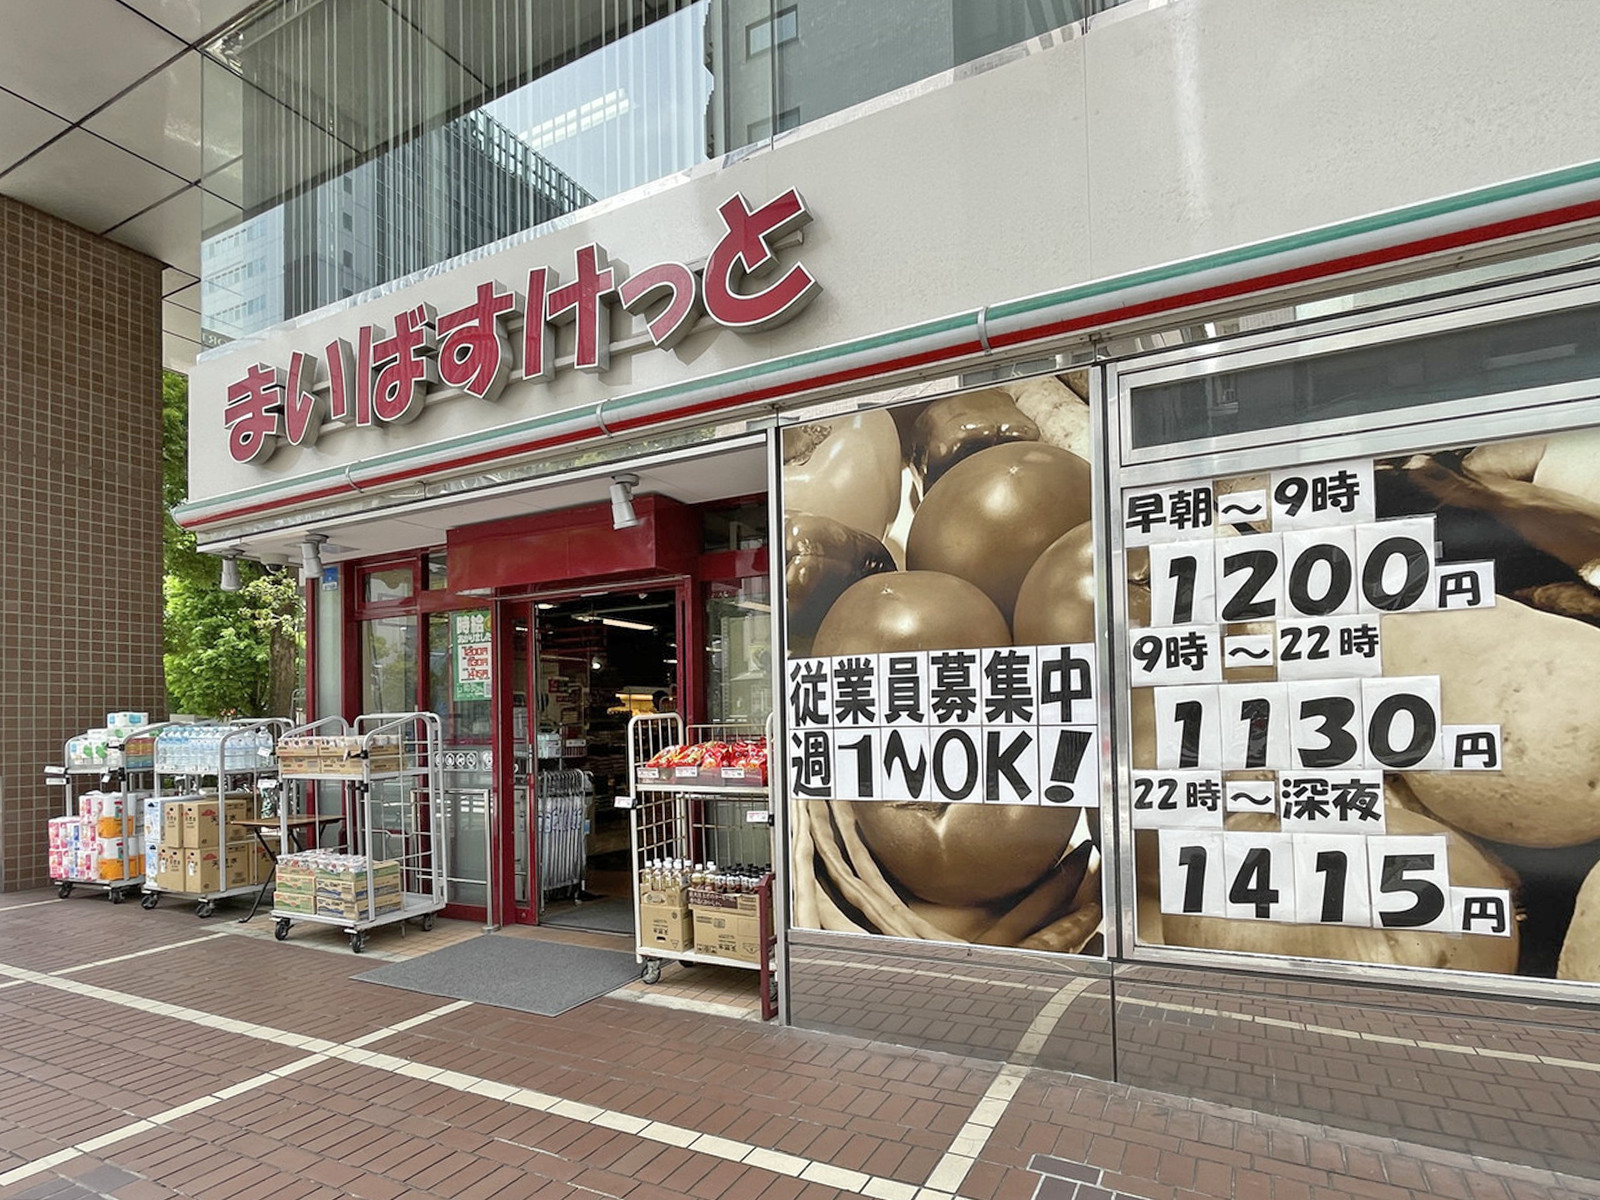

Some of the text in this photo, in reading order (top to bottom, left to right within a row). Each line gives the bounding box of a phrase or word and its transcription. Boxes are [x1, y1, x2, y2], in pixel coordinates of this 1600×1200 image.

[225, 186, 819, 464] まいばすけっと
[1169, 536, 1482, 624] 1200円
[790, 646, 1093, 727] 従業員募集中
[1174, 693, 1498, 768] 1130円
[1178, 845, 1506, 933] 1415円
